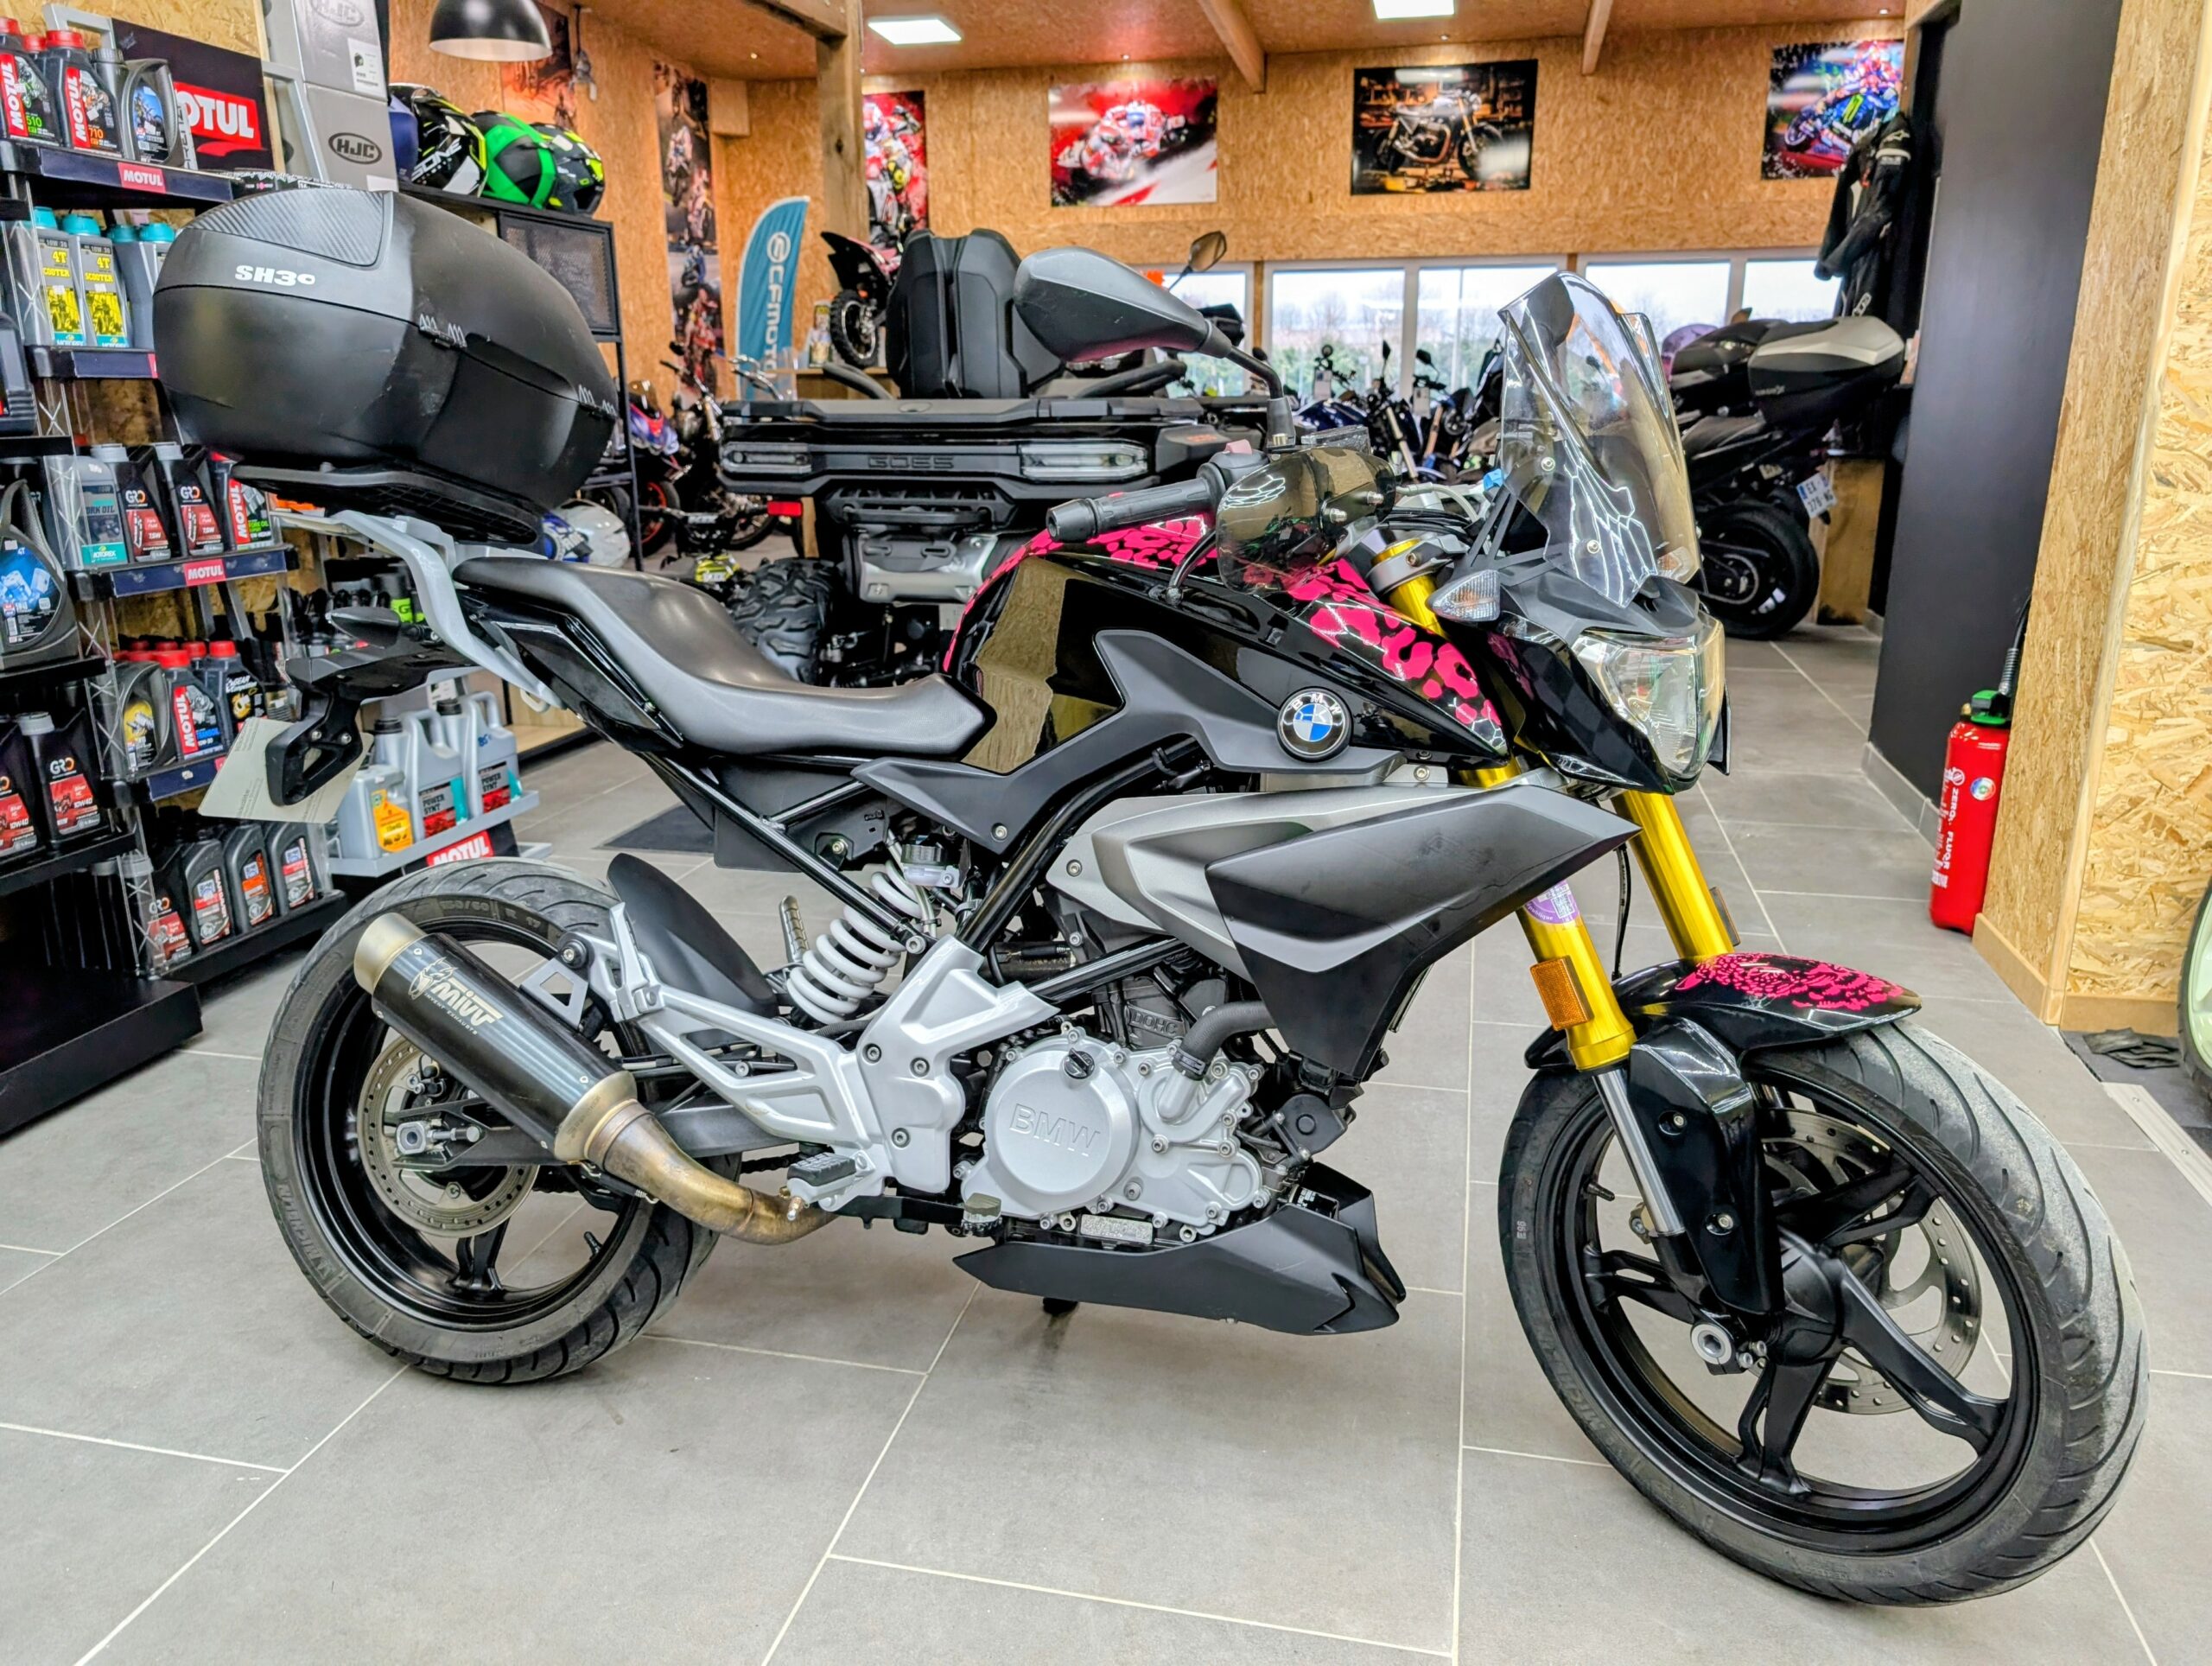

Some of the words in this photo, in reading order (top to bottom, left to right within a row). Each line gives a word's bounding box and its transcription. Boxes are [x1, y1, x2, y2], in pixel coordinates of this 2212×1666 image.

[3, 62, 24, 130] MOTUL
[67, 76, 87, 143] MOTUL
[175, 91, 254, 138] OTUL
[89, 128, 104, 139] 710
[337, 137, 375, 159] HJC
[123, 169, 164, 188] MOTUL
[52, 251, 68, 264] 4T
[97, 257, 111, 269] 4T
[42, 267, 71, 277] COOTER
[85, 272, 114, 283] SCOOTER
[868, 455, 954, 469] GOES
[125, 489, 146, 504] GRO
[180, 486, 200, 499] GRO
[230, 485, 249, 538] MOTUL
[188, 565, 225, 581] MOTUL
[1290, 693, 1342, 715] BMW
[175, 694, 196, 748] MOTUL
[50, 757, 75, 775] GRO
[482, 773, 501, 785] POWER
[73, 798, 93, 809] 10W40
[423, 793, 445, 807] POWER
[423, 804, 441, 816] SYNT
[433, 836, 489, 865] MOTUL
[1131, 1011, 1179, 1036] DOHC
[1008, 1102, 1101, 1157] BMW
